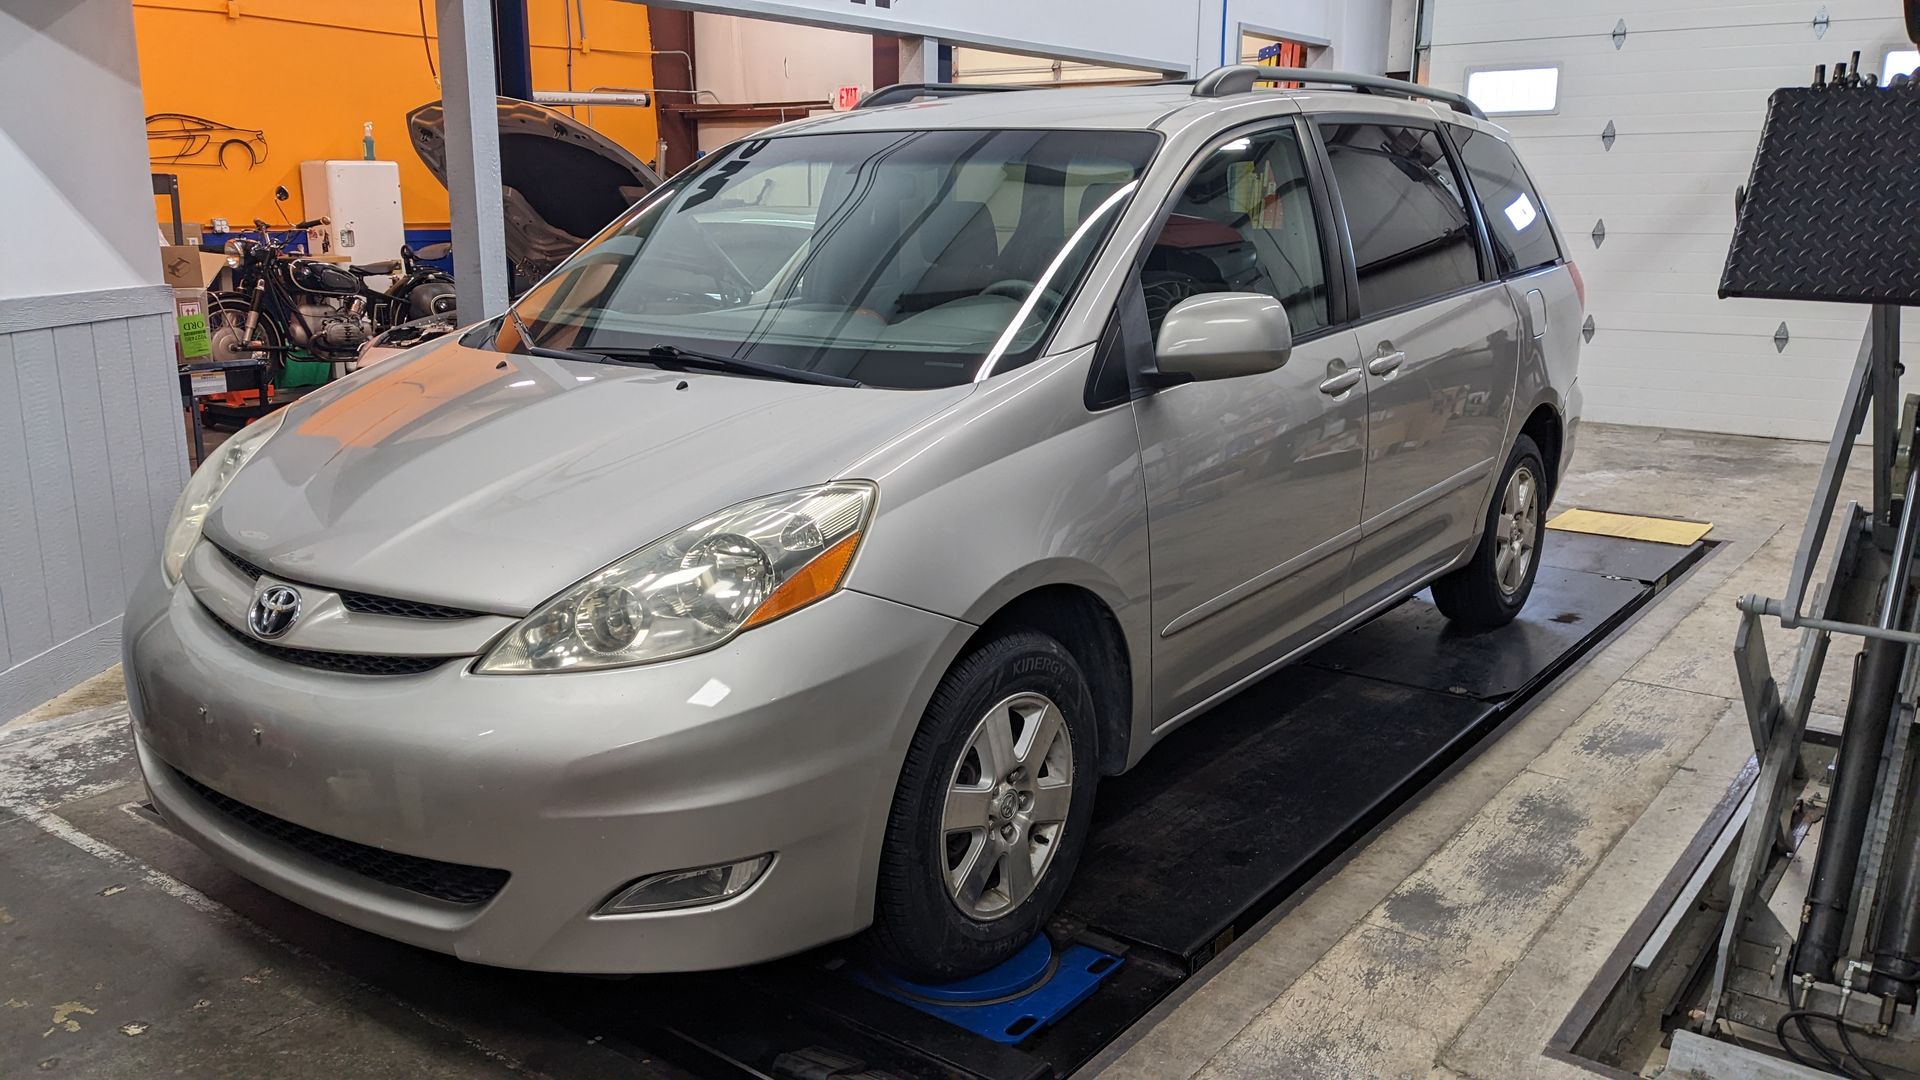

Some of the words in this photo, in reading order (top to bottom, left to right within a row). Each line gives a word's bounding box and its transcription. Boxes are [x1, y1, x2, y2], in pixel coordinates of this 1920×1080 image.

[839, 87, 858, 107] EXIT
[183, 320, 204, 331] ORD
[1012, 656, 1066, 677] KINERGY
